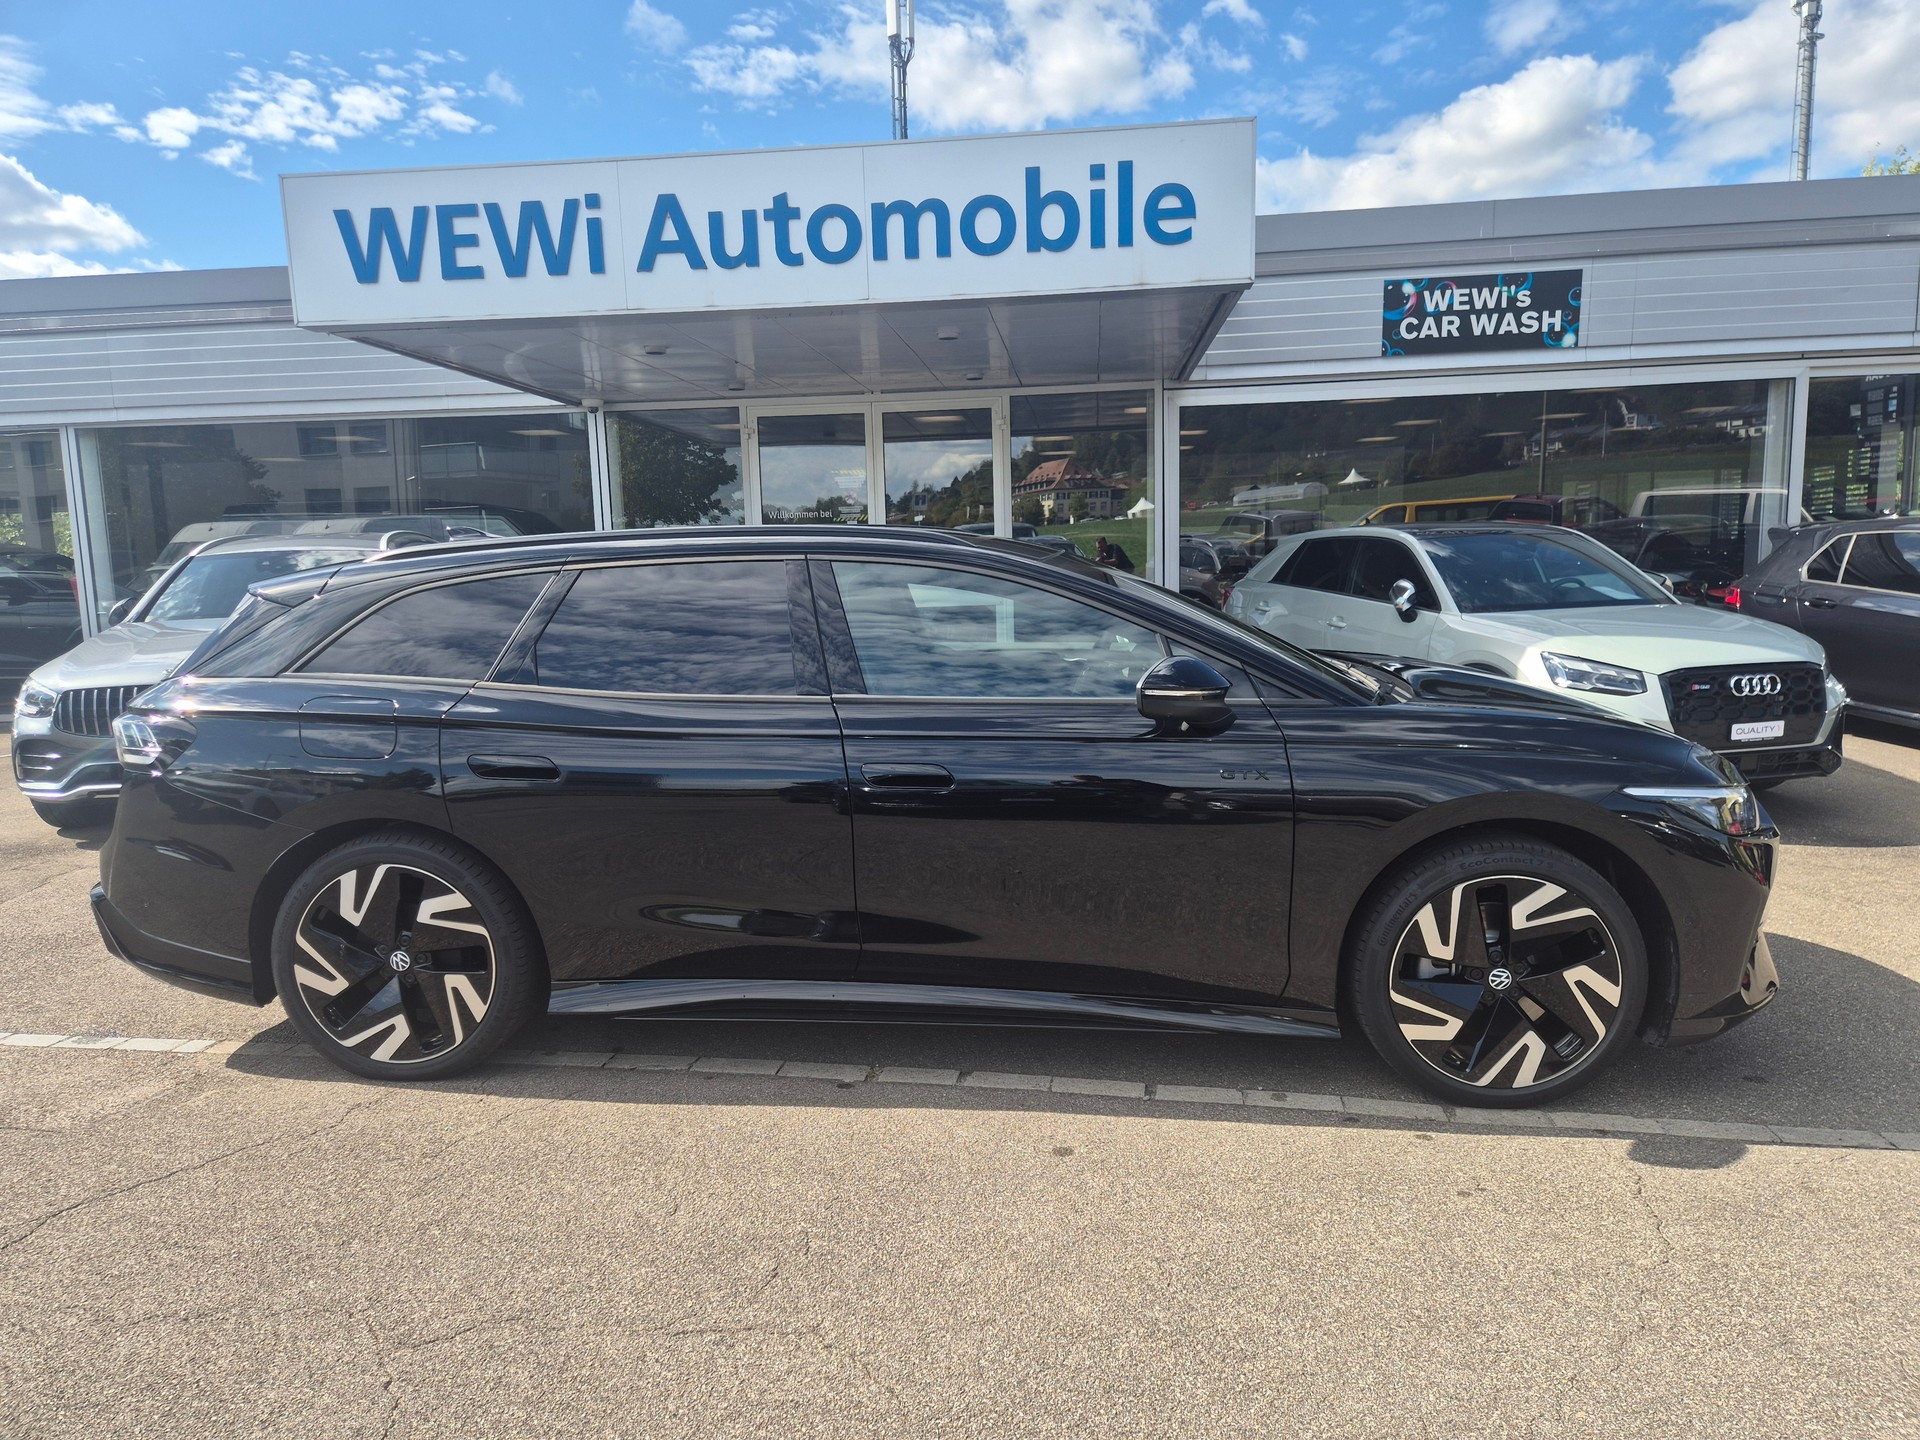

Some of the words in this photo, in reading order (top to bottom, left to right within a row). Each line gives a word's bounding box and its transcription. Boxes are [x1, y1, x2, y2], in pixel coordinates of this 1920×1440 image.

[333, 193, 605, 283] WEWi
[637, 160, 1197, 272] Automobile
[1423, 285, 1532, 312] WEWi's
[1399, 315, 1461, 340] CAR
[1469, 309, 1562, 336] WASH
[768, 510, 819, 519] Willkommen
[820, 509, 833, 518] bei
[1735, 724, 1776, 736] QUALITY
[1220, 768, 1270, 781] GTX
[1459, 856, 1534, 871] EcoContact
[1377, 896, 1414, 947] Continental
